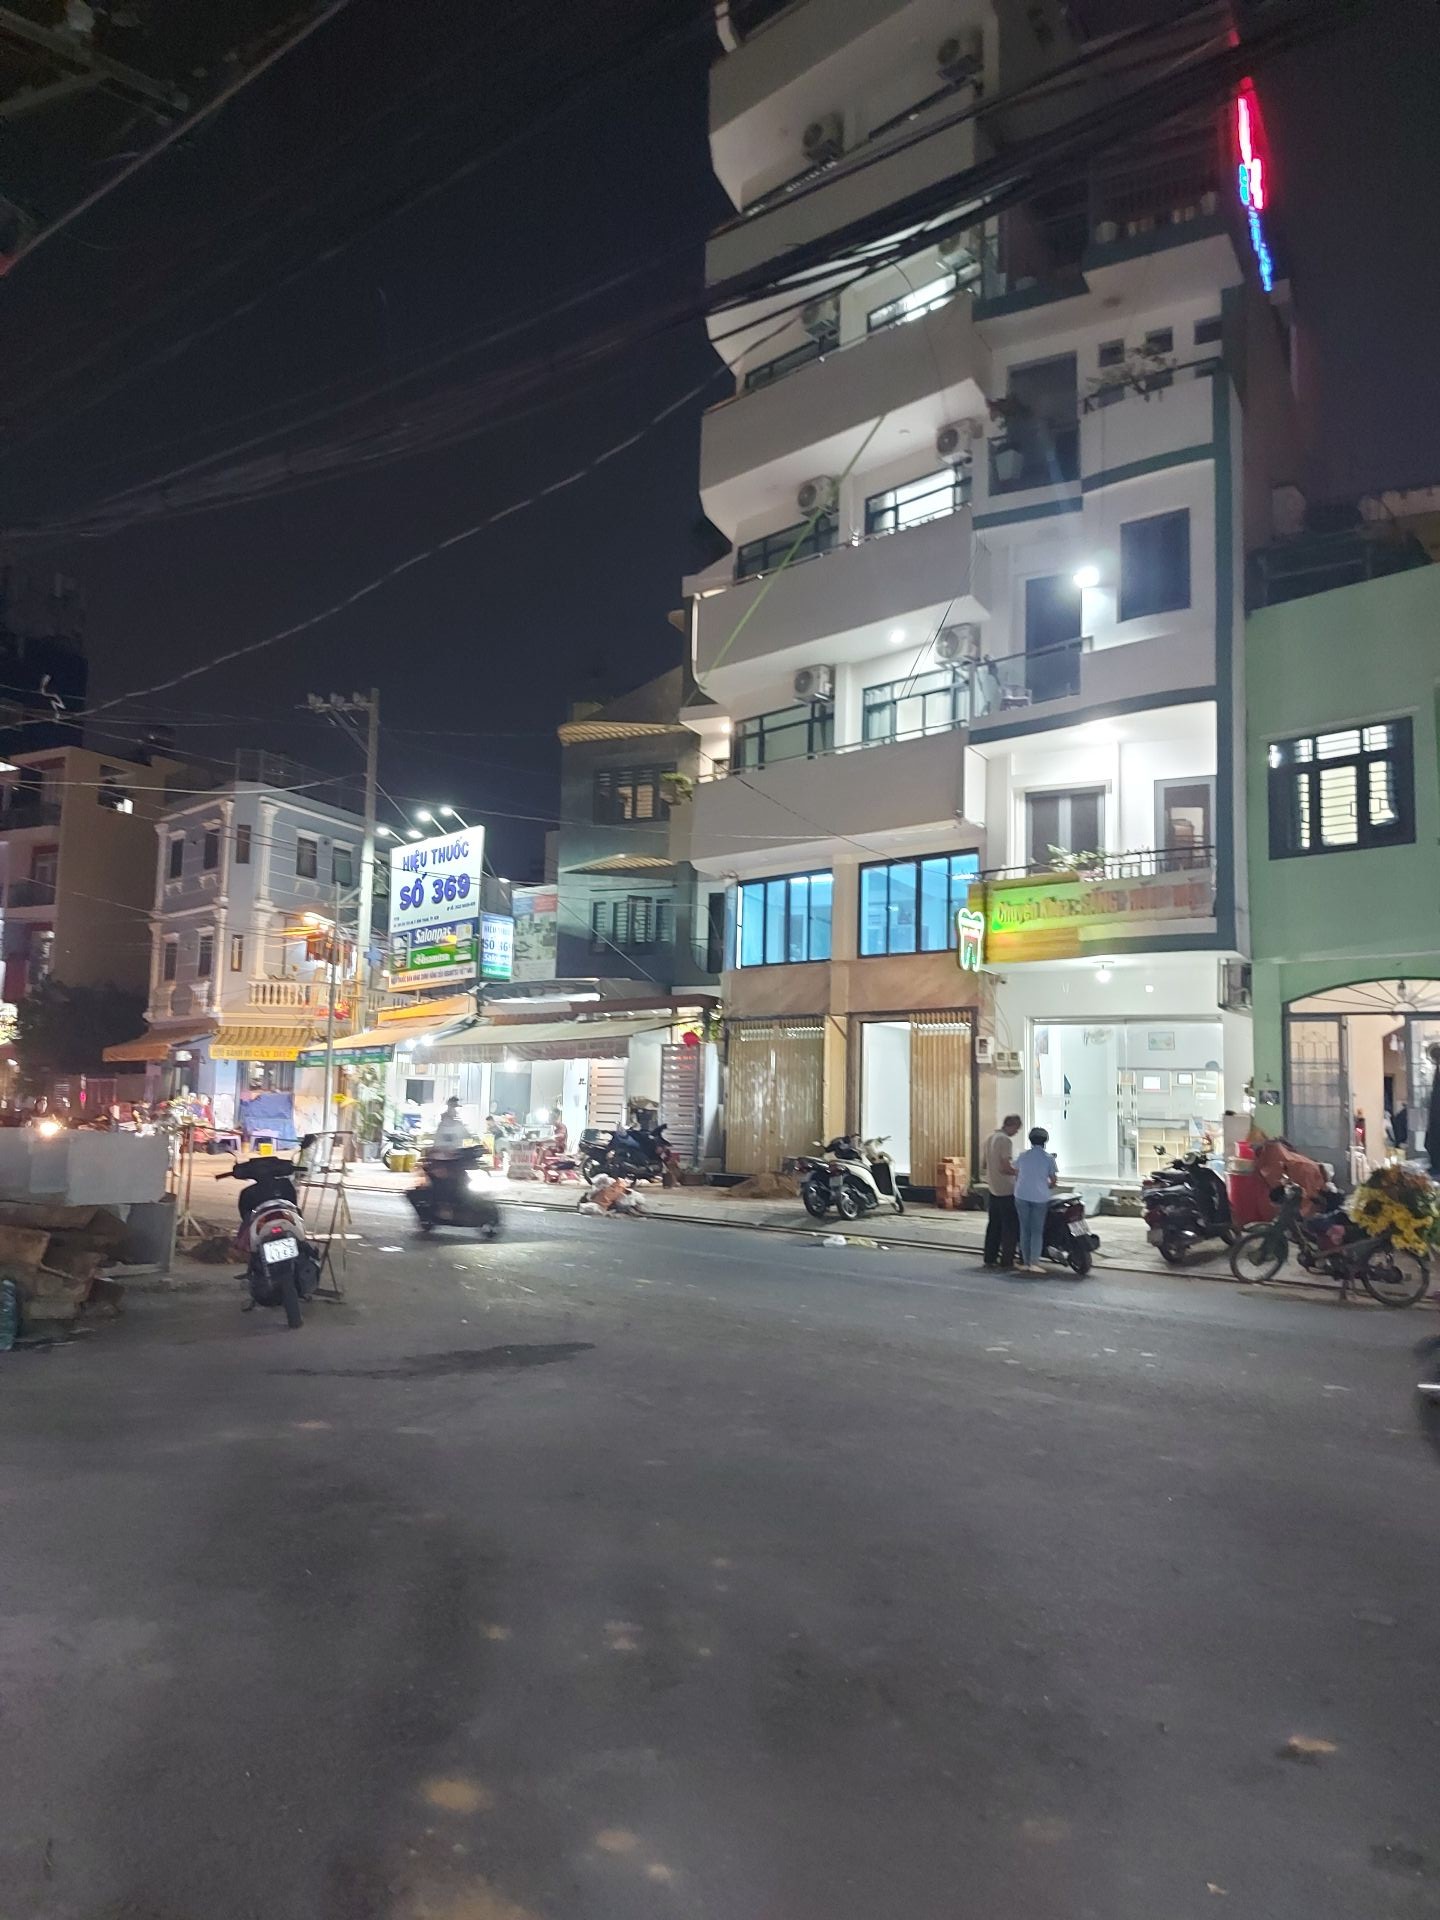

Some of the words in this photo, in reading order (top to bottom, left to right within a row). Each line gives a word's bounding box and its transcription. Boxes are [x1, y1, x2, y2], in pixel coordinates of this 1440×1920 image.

[402, 850, 427, 872] HIỆU
[431, 837, 469, 864] THUỐC
[399, 872, 427, 910] SỐ
[431, 873, 470, 904] 369
[414, 926, 452, 944] Salonpas
